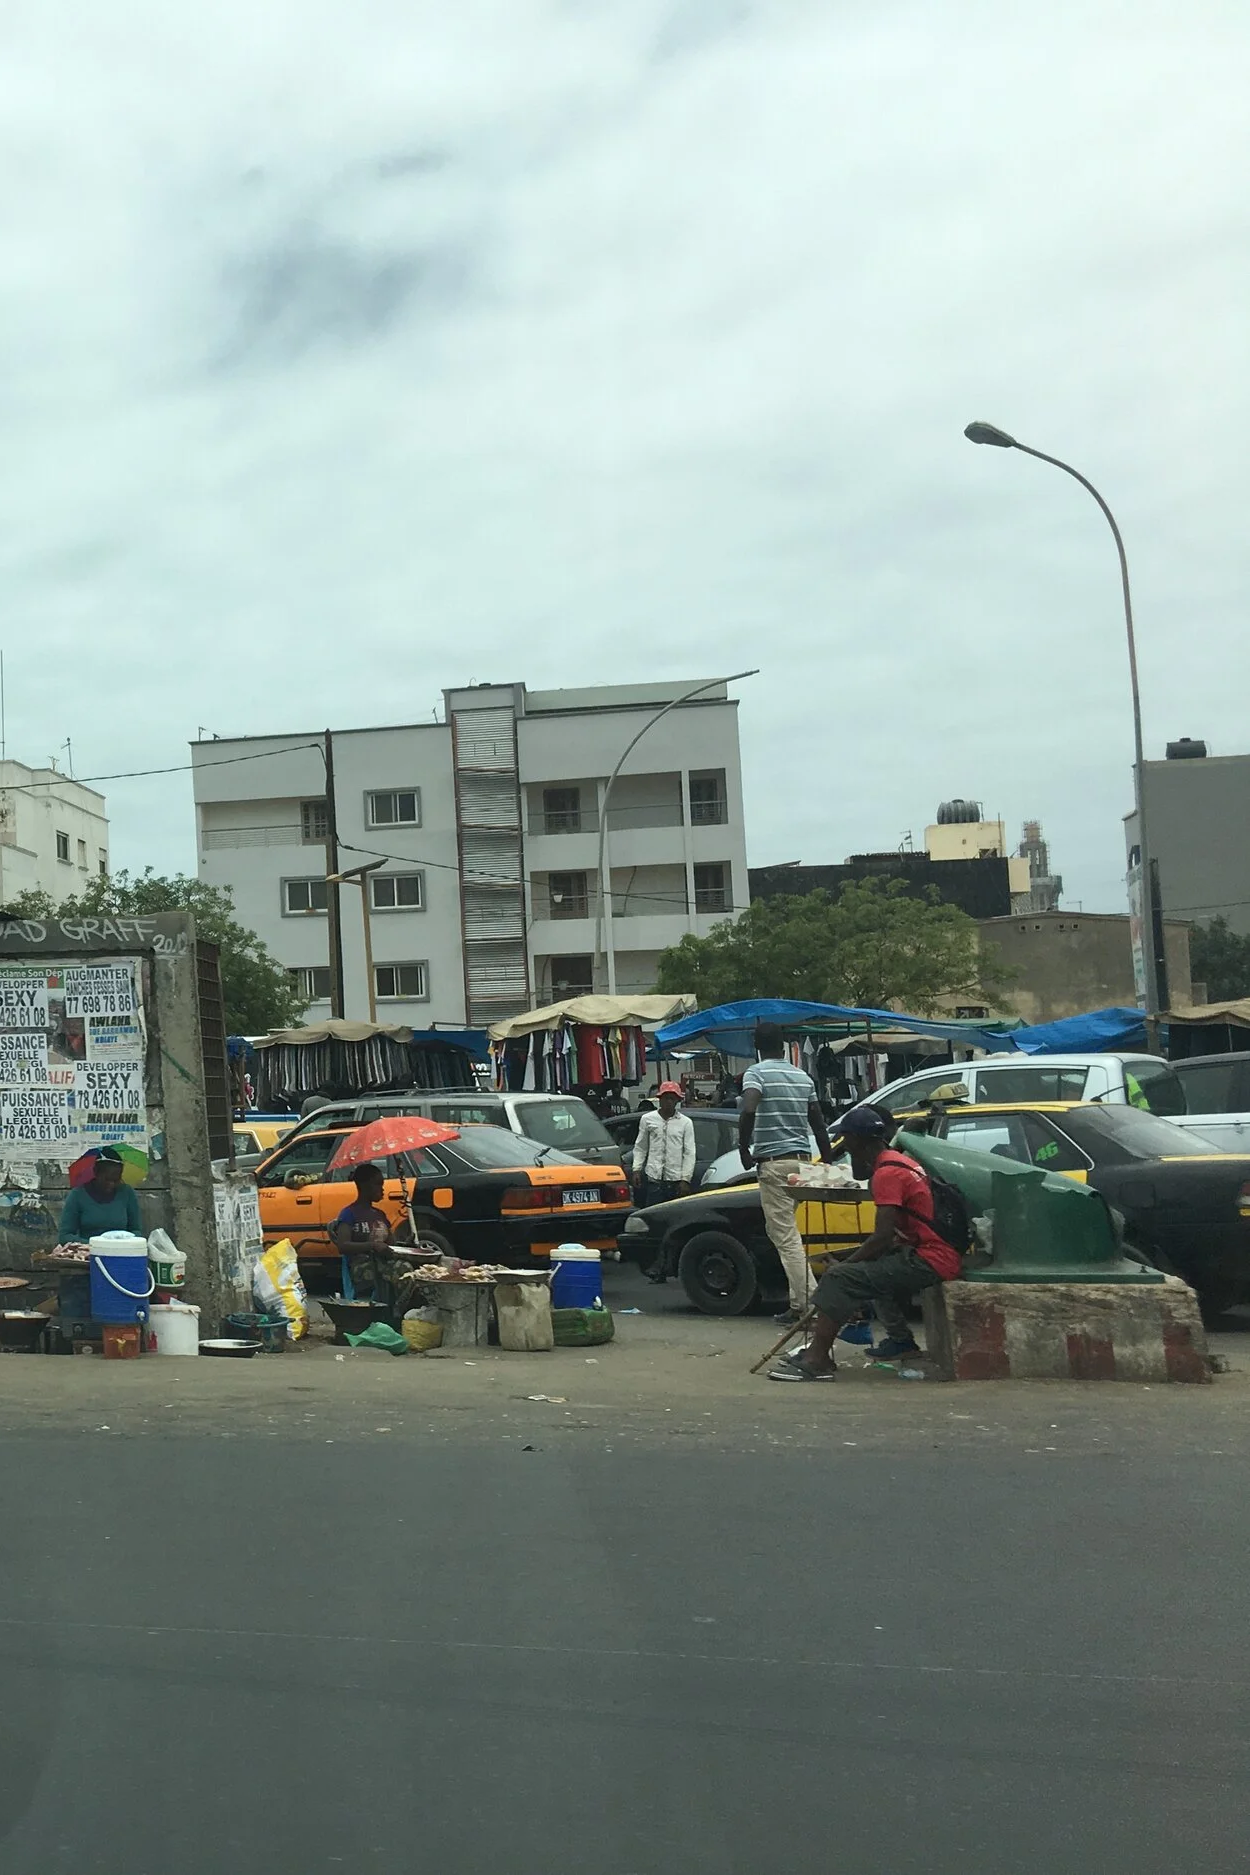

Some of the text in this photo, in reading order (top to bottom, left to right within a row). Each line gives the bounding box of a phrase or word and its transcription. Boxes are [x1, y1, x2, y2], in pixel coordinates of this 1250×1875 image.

[60, 918, 156, 942] GRAFF
[28, 969, 44, 977] Son
[66, 969, 128, 981] AUGMANTER
[67, 995, 131, 1013] 77 698 78 86
[0, 1008, 16, 1026] 426
[20, 1008, 30, 1026] 61
[34, 1007, 45, 1026] 08
[77, 1063, 138, 1071] DEVELOPPER
[0, 1069, 17, 1082] 426
[20, 1068, 31, 1081] 61
[35, 1068, 47, 1081] 08
[87, 1073, 131, 1089] SEXY
[2, 1093, 65, 1107] PUISSANCE
[78, 1089, 139, 1109] 78 426 61 08
[13, 1108, 59, 1117] SEXUELLE
[3, 1125, 67, 1139] 78 426 61 08
[1036, 1141, 1058, 1160] 46
[563, 1191, 597, 1203] DK-4974-AN
